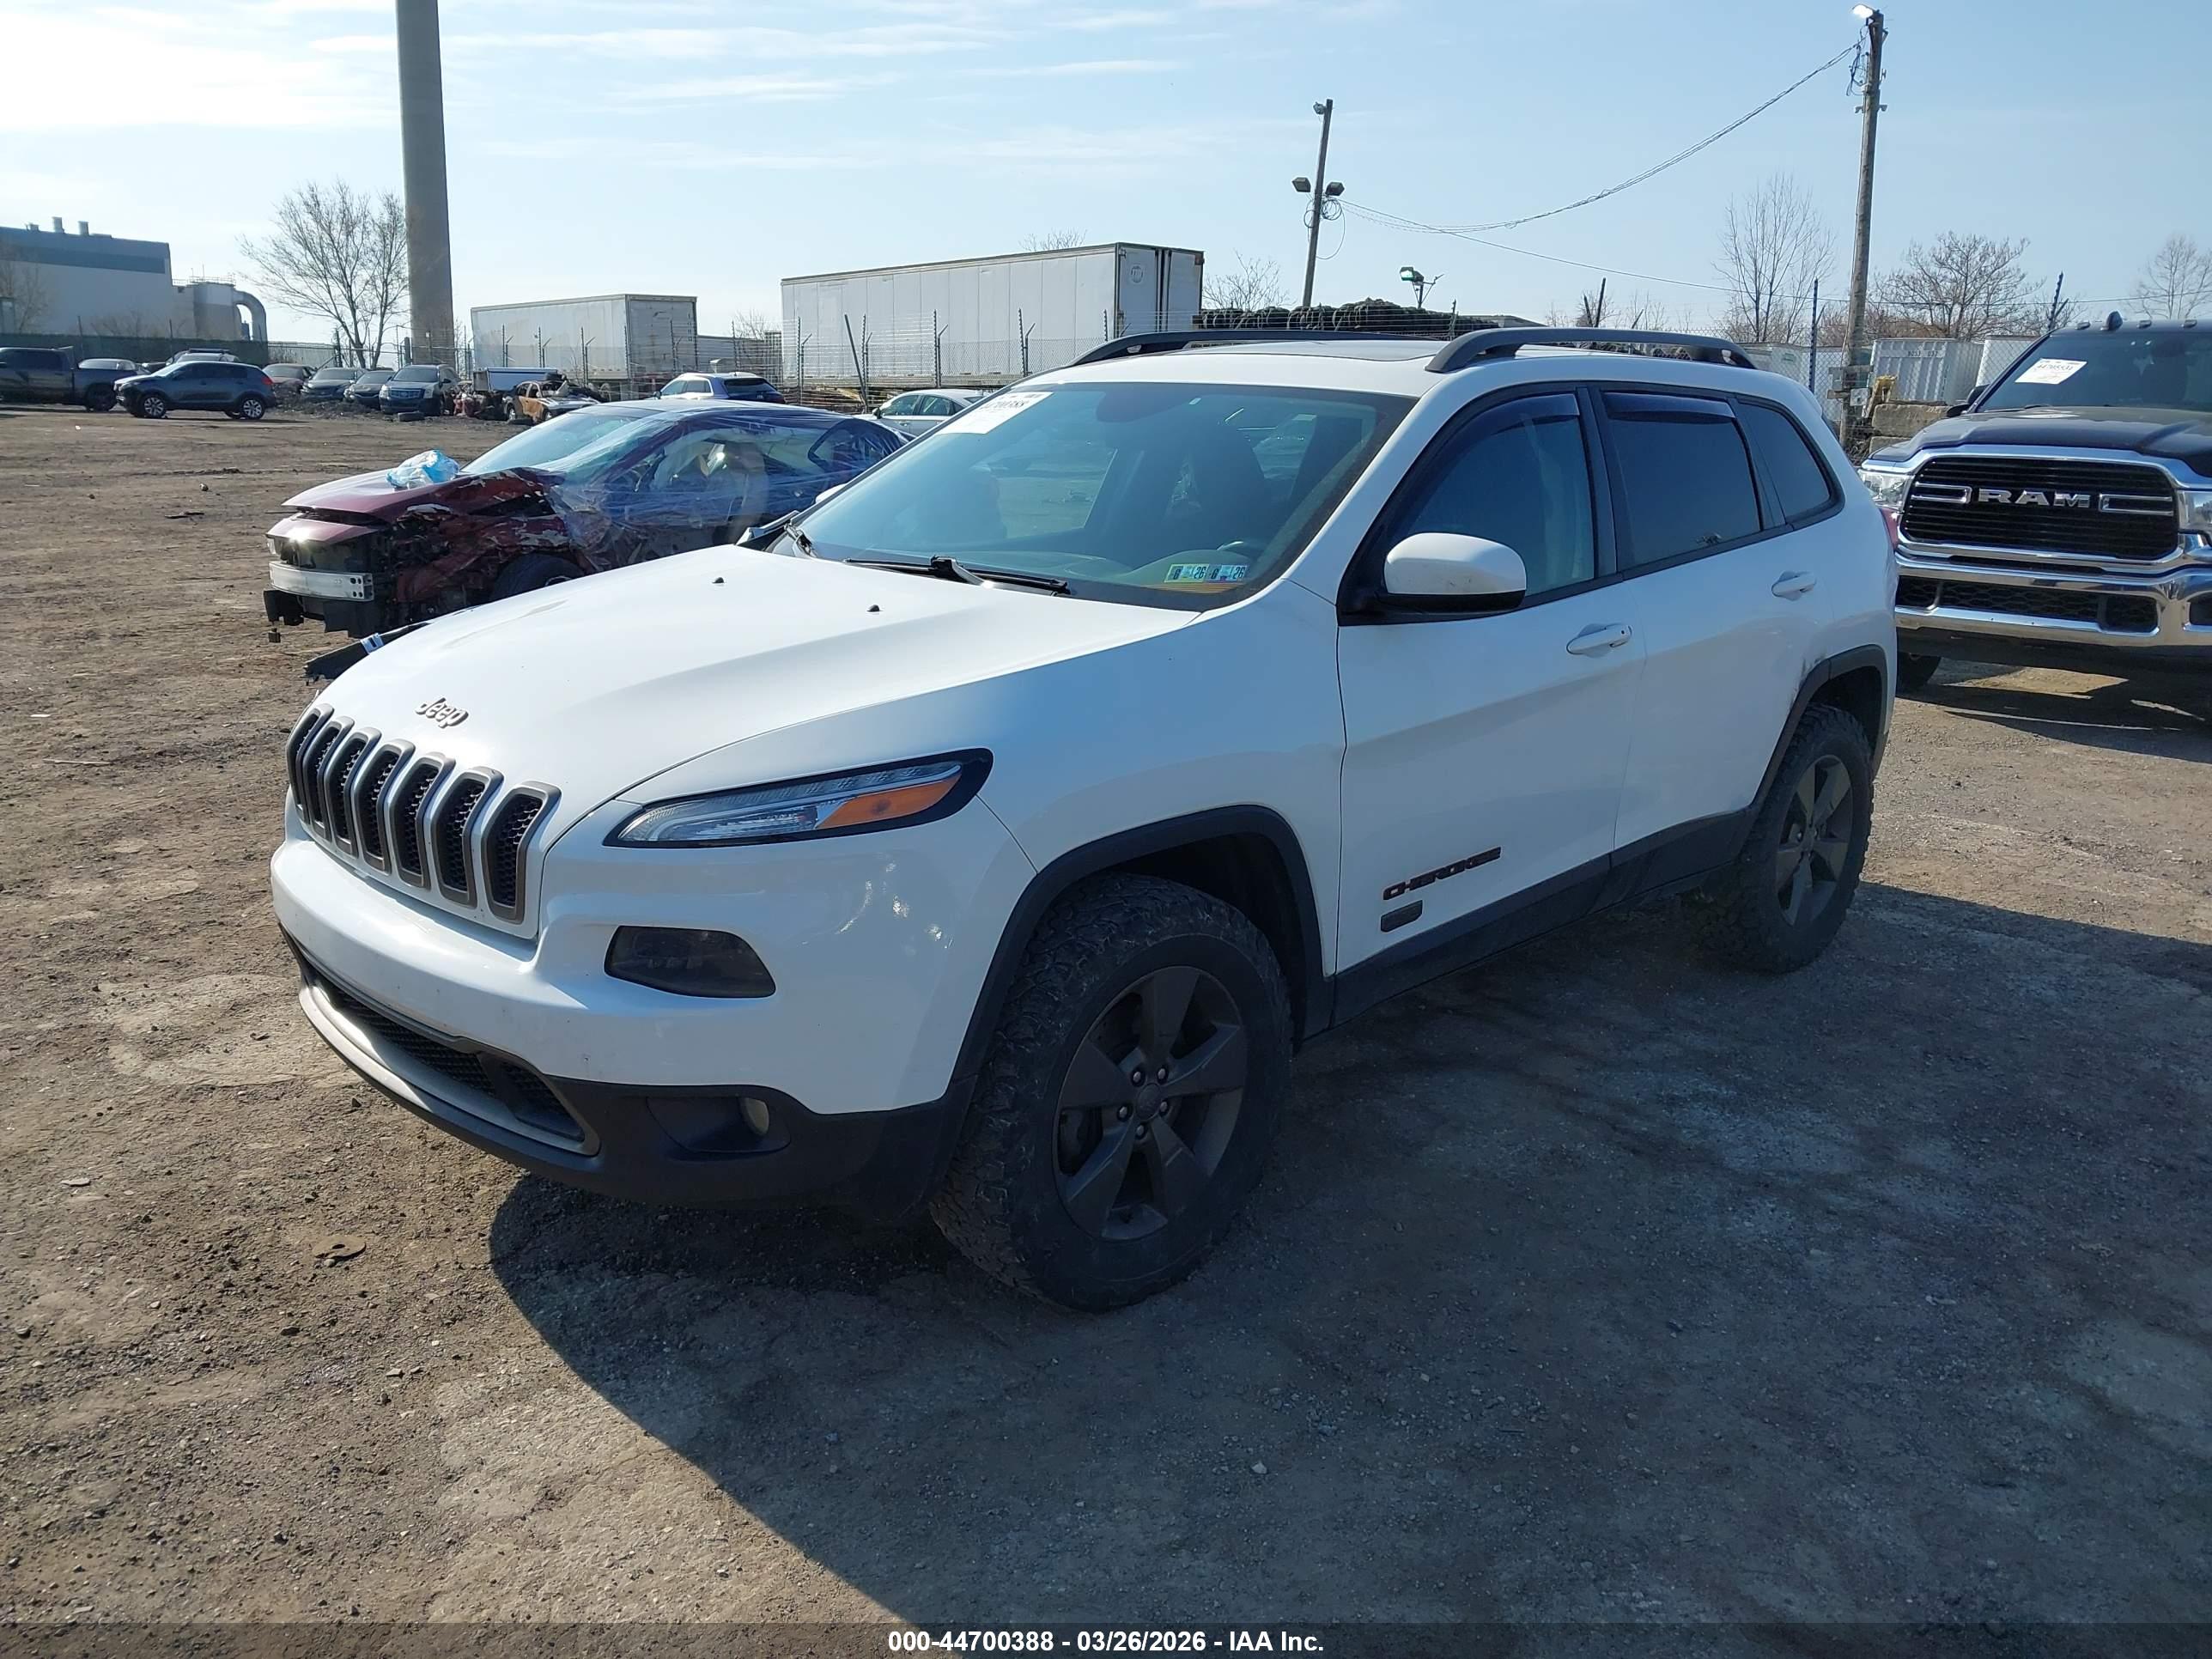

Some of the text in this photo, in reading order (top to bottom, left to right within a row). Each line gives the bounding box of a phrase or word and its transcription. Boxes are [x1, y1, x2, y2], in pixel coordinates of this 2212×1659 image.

[1978, 488, 2091, 507] RAM
[1194, 567, 1206, 579] 26
[415, 697, 469, 729] Jeep
[1382, 846, 1501, 900] CHEROKEE
